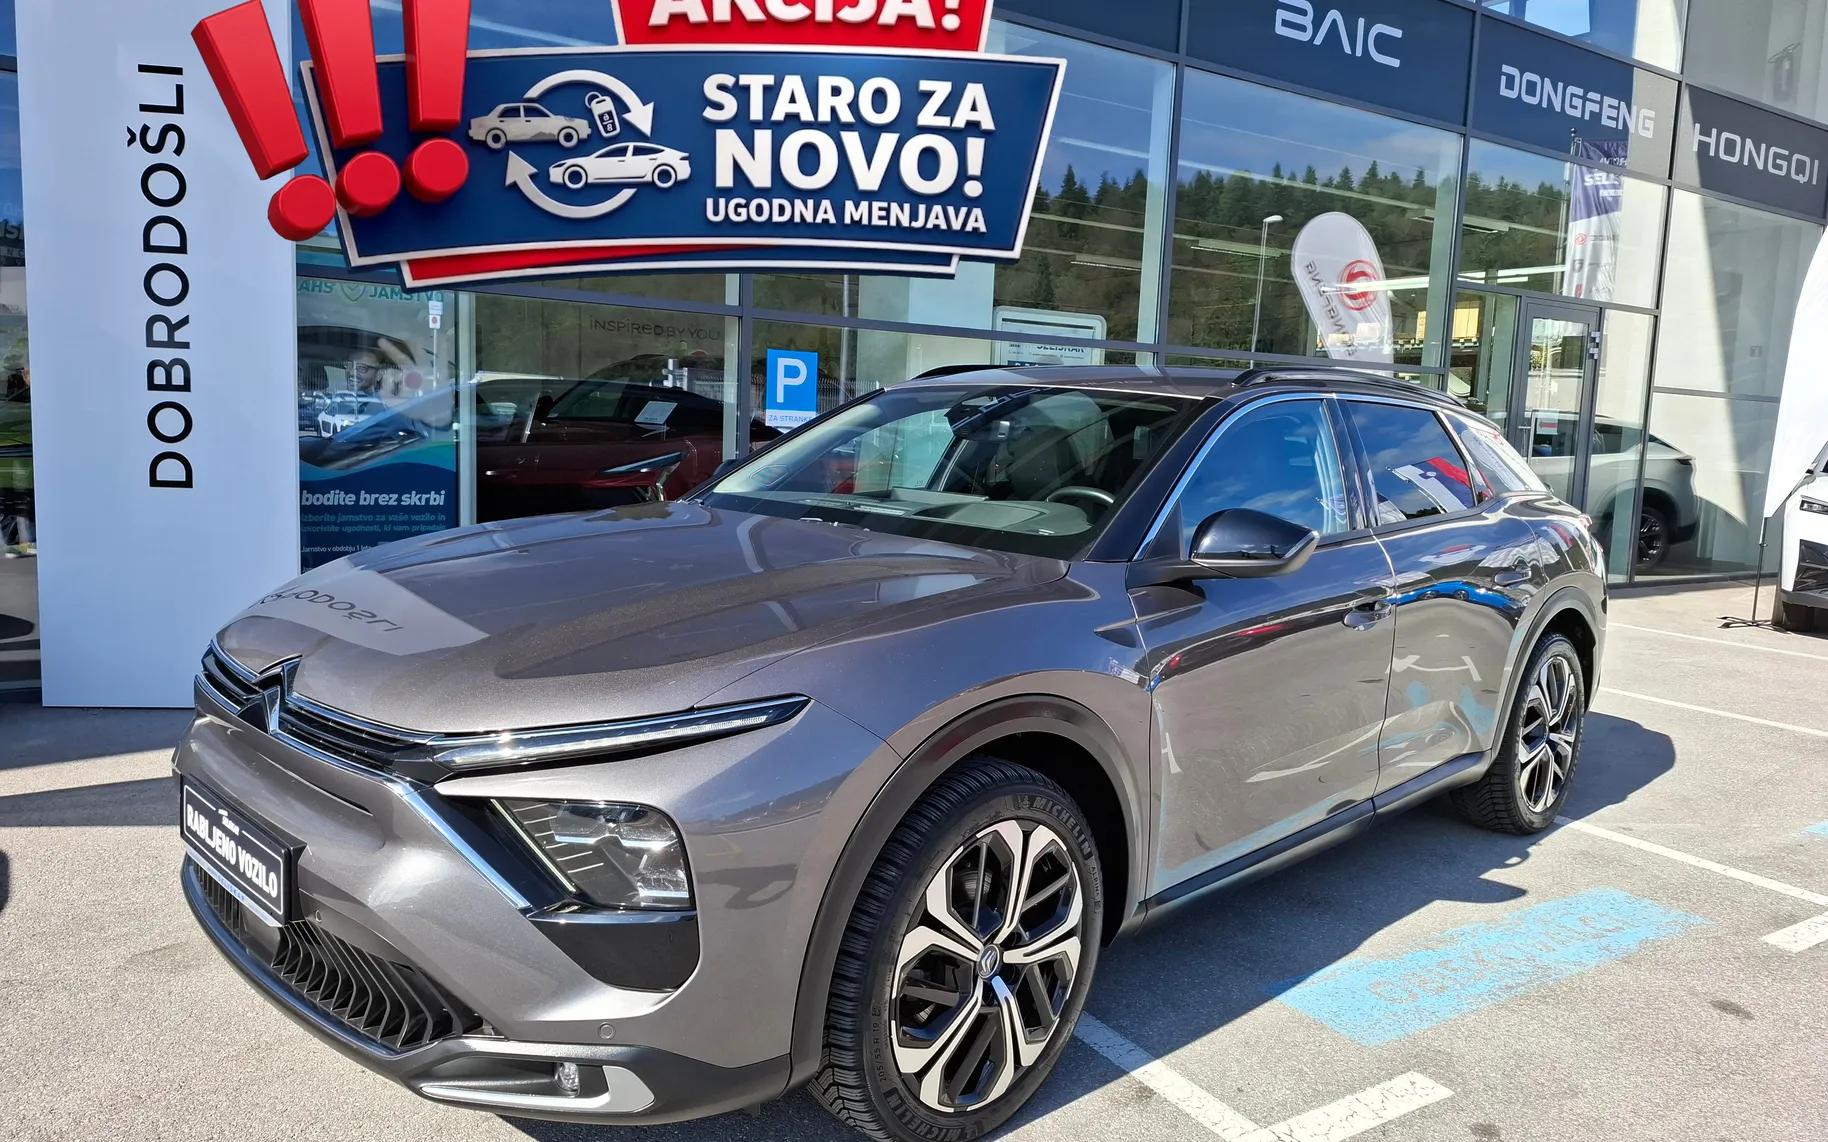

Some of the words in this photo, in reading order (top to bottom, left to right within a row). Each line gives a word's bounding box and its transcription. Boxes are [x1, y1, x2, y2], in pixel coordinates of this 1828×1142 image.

[1275, 0, 1403, 68] BAIC
[1500, 64, 1656, 139] DONGFENG
[1692, 122, 1819, 186] HONGQI
[127, 63, 193, 489] DOBRODOŠLI
[776, 357, 808, 403] P
[301, 490, 356, 506] bodite
[359, 490, 398, 506] brez
[401, 490, 446, 506] skrbi
[187, 804, 237, 865] RABLJENO
[238, 846, 278, 898] VOZILO
[1033, 796, 1092, 855] MICHELIN
[886, 1093, 962, 1141] MICHELIN
